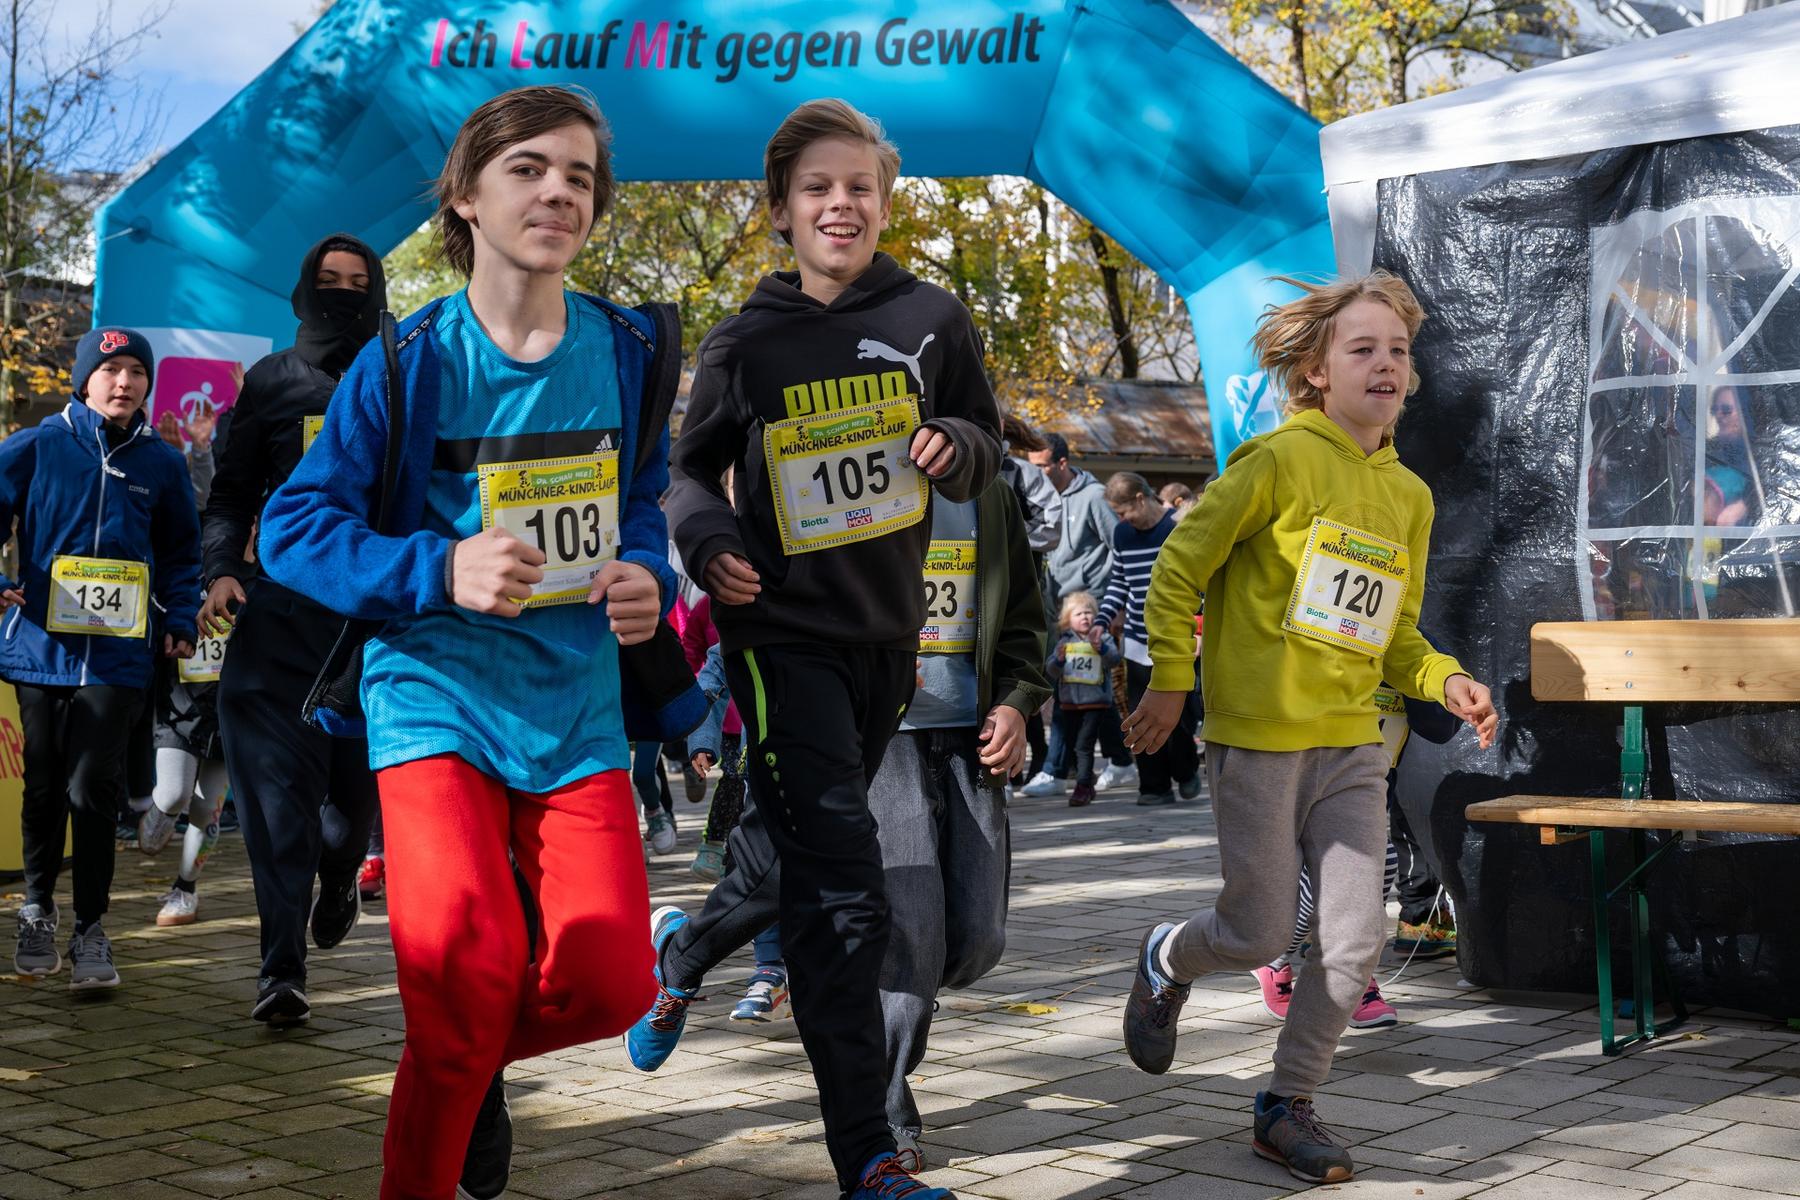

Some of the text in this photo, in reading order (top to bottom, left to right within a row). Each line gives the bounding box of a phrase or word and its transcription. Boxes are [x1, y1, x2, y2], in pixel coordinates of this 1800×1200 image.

[430, 12, 1046, 83] Ich Lauf Mit gegen Gewalt
[780, 420, 907, 457] MÜNCHNER-KINDL-LAUF
[498, 476, 616, 503] MÜNCHNER-KINDL-LAUF
[812, 450, 890, 505] 105
[801, 516, 830, 528] Biotta
[846, 507, 871, 519] LIQUI
[848, 517, 873, 528] MOLY
[525, 503, 600, 564] 103
[1319, 541, 1406, 577] MÜNCHNER-KINDL-LAUF
[76, 584, 122, 613] 134
[1333, 568, 1384, 618] 120
[1306, 607, 1329, 620] Biotta
[1339, 625, 1358, 637] MOLY
[198, 640, 231, 661] 13
[1072, 656, 1093, 671] 124
